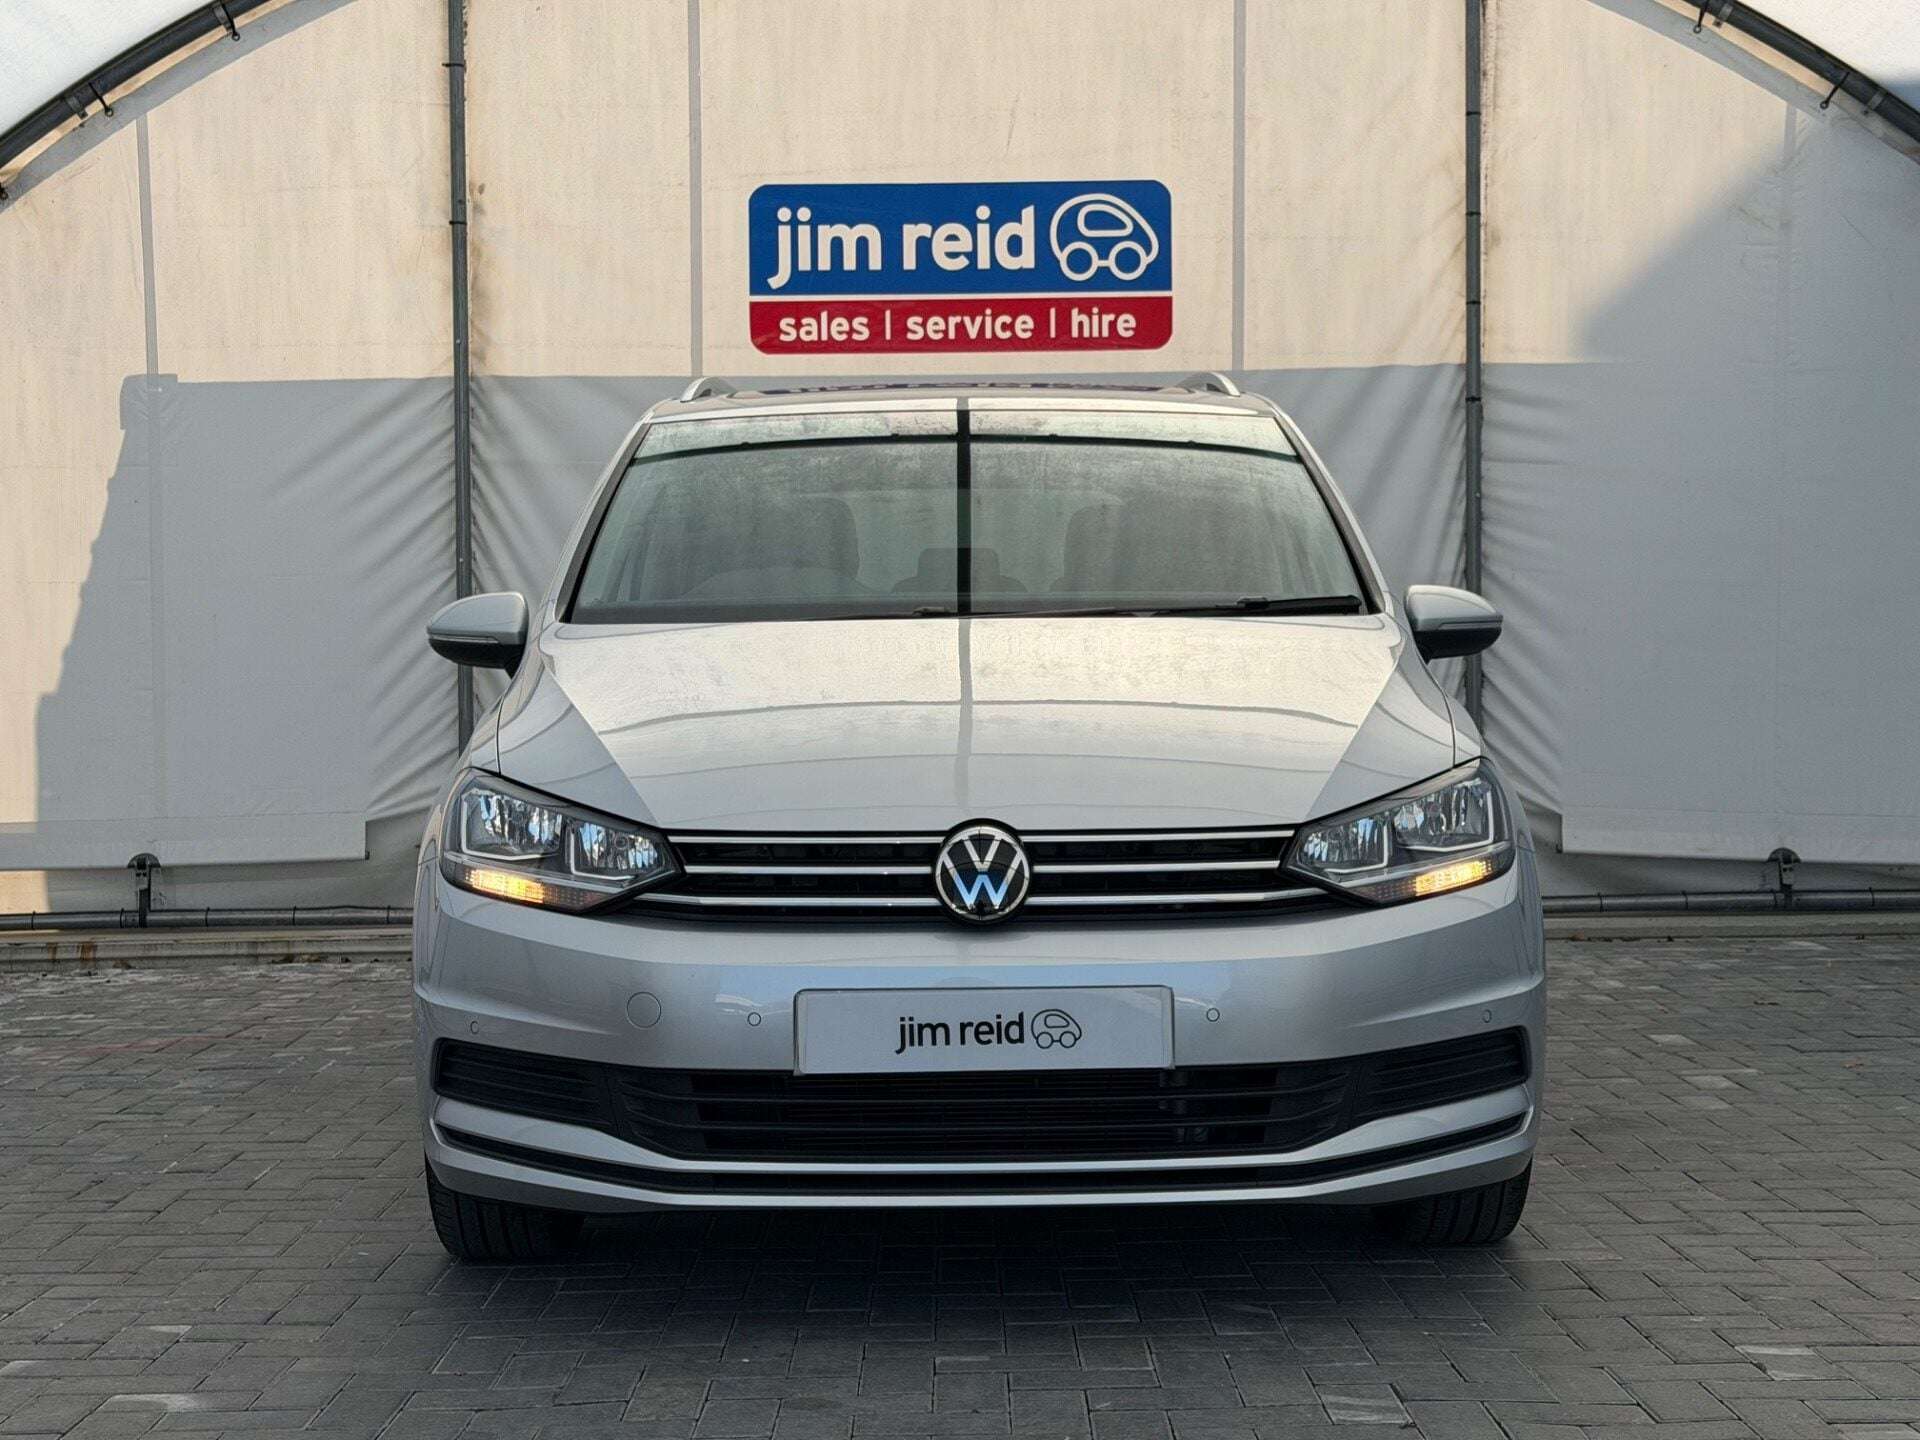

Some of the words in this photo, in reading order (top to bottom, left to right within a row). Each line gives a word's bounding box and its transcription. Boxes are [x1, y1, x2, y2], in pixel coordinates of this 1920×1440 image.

[767, 206, 882, 290] jim
[903, 205, 1035, 271] reid
[779, 310, 870, 342] sales
[906, 308, 1034, 341] service
[1071, 307, 1137, 339] hire
[895, 1016, 950, 1054] jim
[959, 1012, 1025, 1047] reid
